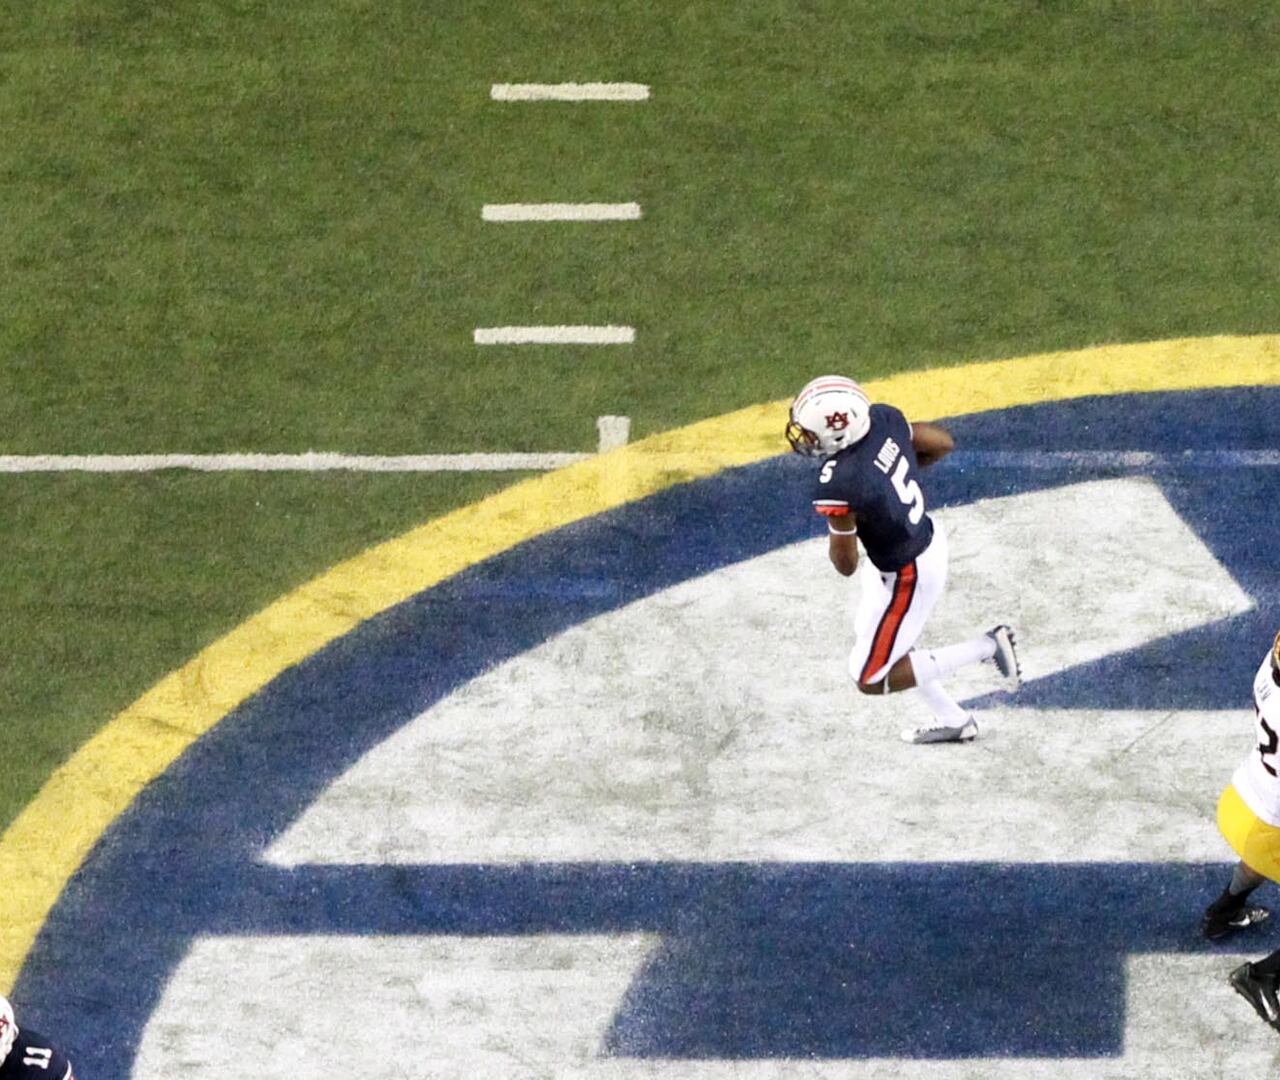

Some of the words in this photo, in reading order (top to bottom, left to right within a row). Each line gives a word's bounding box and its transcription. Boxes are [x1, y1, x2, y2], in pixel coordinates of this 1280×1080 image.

[819, 460, 837, 483] 5
[890, 455, 925, 525] 5
[23, 1047, 52, 1069] 11
